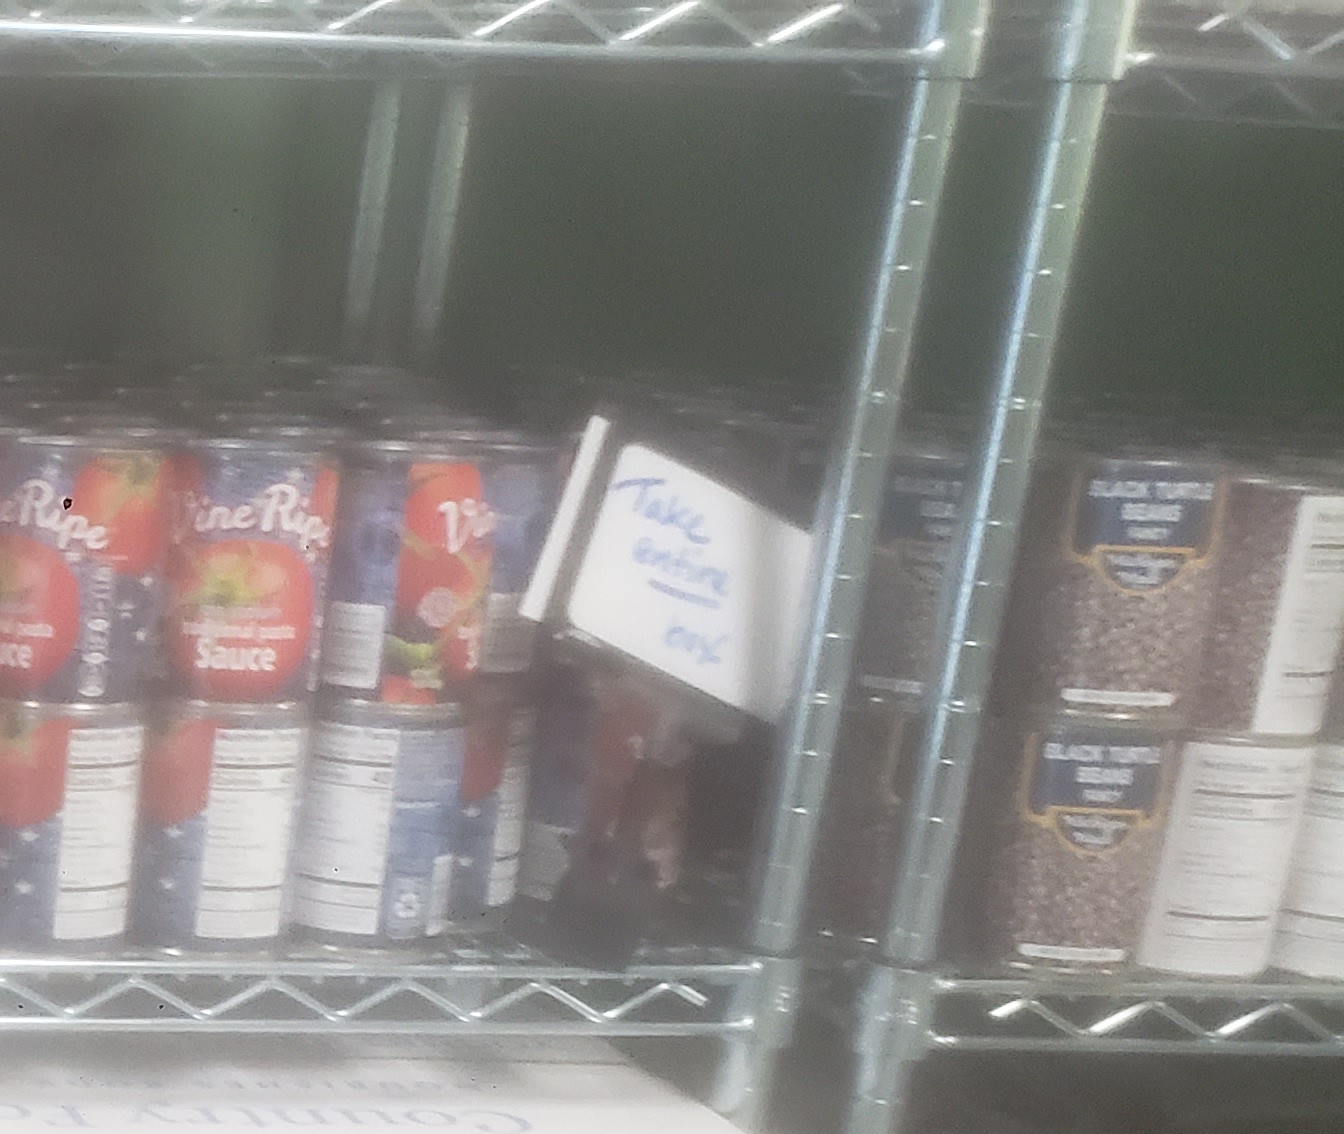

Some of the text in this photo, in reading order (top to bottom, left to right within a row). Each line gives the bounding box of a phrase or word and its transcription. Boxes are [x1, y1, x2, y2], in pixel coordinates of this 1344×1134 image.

[12, 478, 110, 550] Ripe
[615, 477, 710, 545] Take
[194, 635, 277, 672] Sauce
